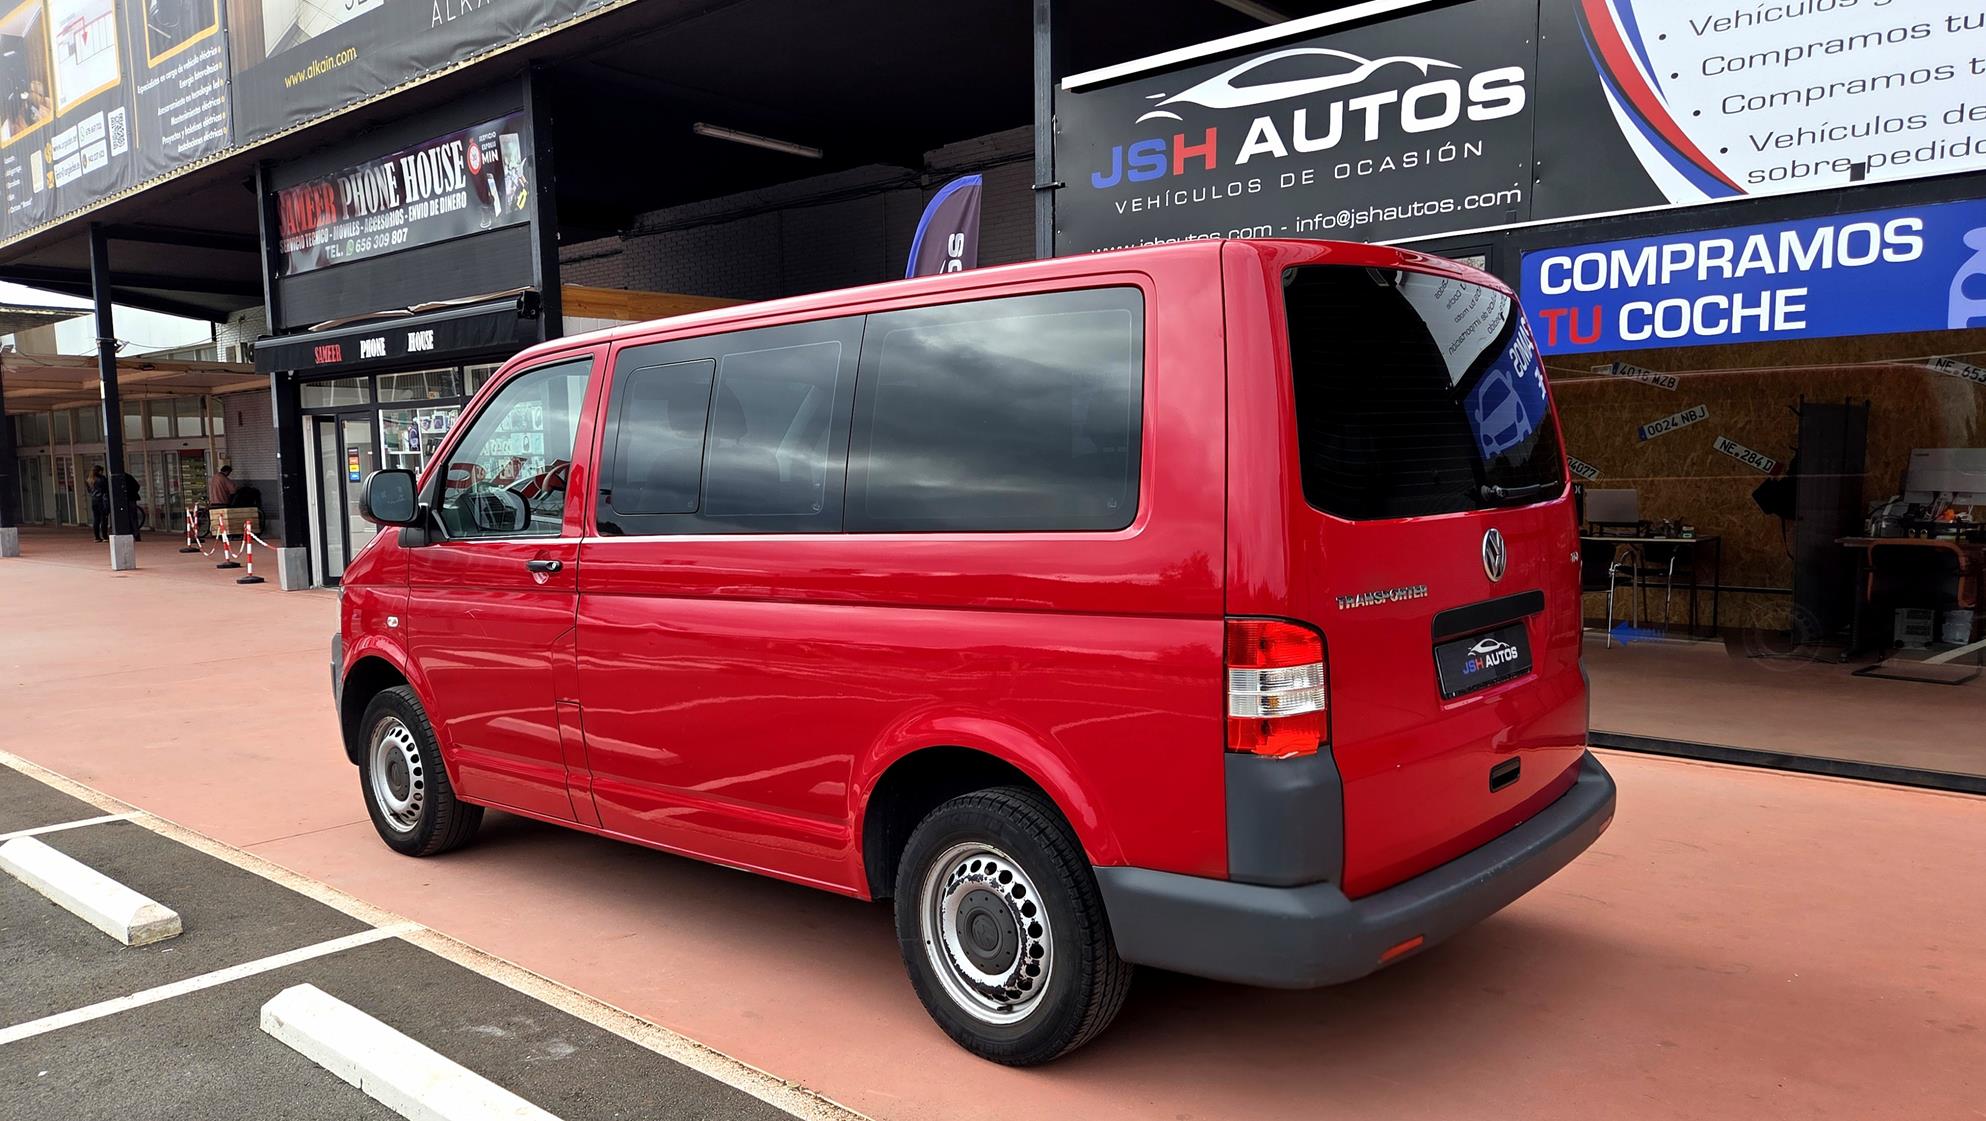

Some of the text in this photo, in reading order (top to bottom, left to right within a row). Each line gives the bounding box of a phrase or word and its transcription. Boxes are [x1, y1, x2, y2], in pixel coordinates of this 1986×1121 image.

[1702, 12, 1985, 76] Compramos tu
[284, 46, 358, 89] www.alkain.com
[1721, 57, 1986, 116] Compramos t
[1091, 66, 1527, 190] JSH AUTOS
[1749, 113, 1928, 153] Vehículos
[481, 149, 499, 165] MIN
[1114, 140, 1484, 215] VEHÍCULOS DE OCASIÓN
[1747, 157, 1852, 184] sobre
[337, 161, 400, 221] PHONE
[400, 140, 467, 204] HOUSE
[429, 198, 440, 217] DE
[1296, 188, 1522, 234] info@jshautos.com
[355, 238, 373, 253] 656
[373, 232, 390, 249] 309
[391, 227, 408, 245] 807
[1539, 217, 1924, 296] COMPRAMOS
[1539, 287, 1808, 347] TU COCHE
[314, 330, 434, 364] SAMEER PHONE HOUSE
[1647, 406, 1706, 436] 0024 NBJ
[1336, 584, 1428, 610] TRANSPORTER
[1462, 646, 1519, 674] JSH AUTOS
